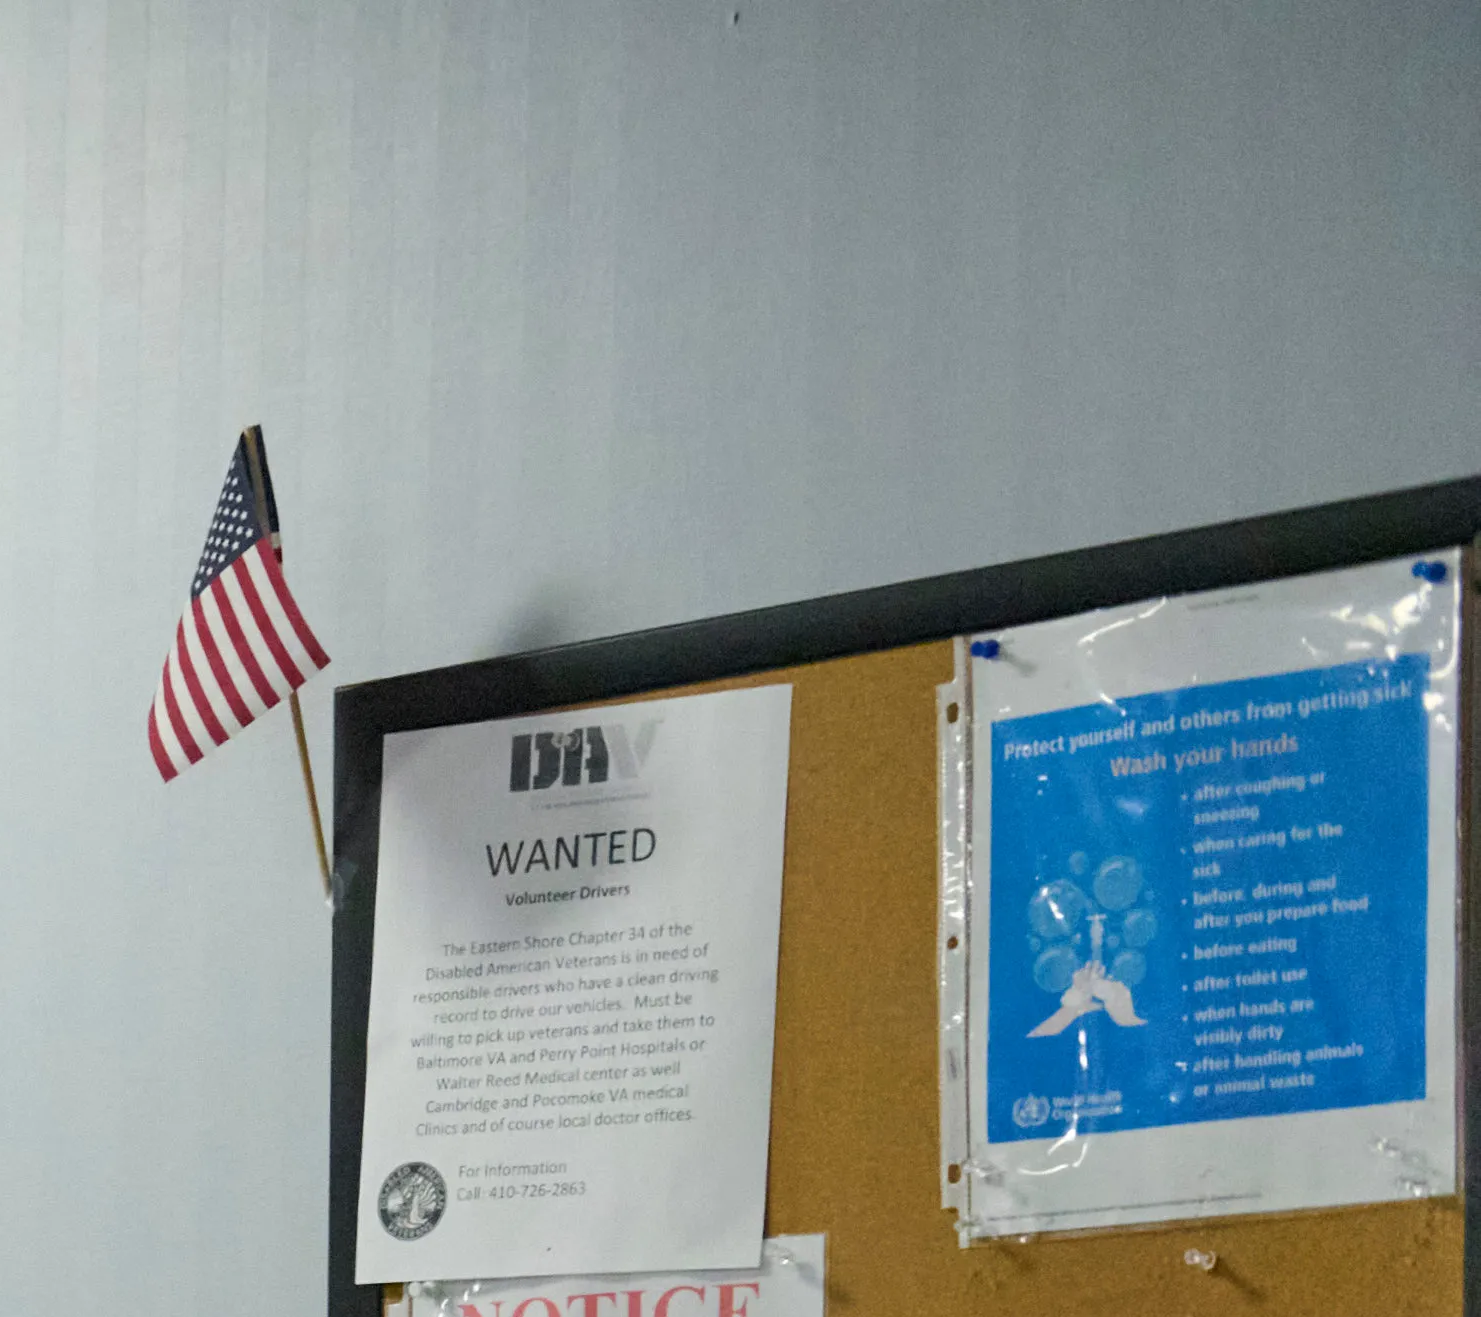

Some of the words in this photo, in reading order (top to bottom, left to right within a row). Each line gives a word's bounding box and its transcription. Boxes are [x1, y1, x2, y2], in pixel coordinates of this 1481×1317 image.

[1004, 737, 1064, 760] Protect
[1069, 720, 1135, 751] yourself
[1142, 714, 1175, 736] and
[1180, 707, 1240, 730] others
[1247, 699, 1291, 721] from
[1111, 754, 1167, 777] Wash
[1173, 747, 1227, 773] your
[1231, 733, 1299, 759] hands
[486, 828, 656, 877] WANTED
[505, 889, 576, 906] Volunteer
[579, 884, 631, 900] Drivers
[470, 940, 521, 954] Eastern
[458, 1165, 479, 1178] For
[484, 1161, 567, 1177] Information
[489, 1181, 587, 1199] 410-726-2863
